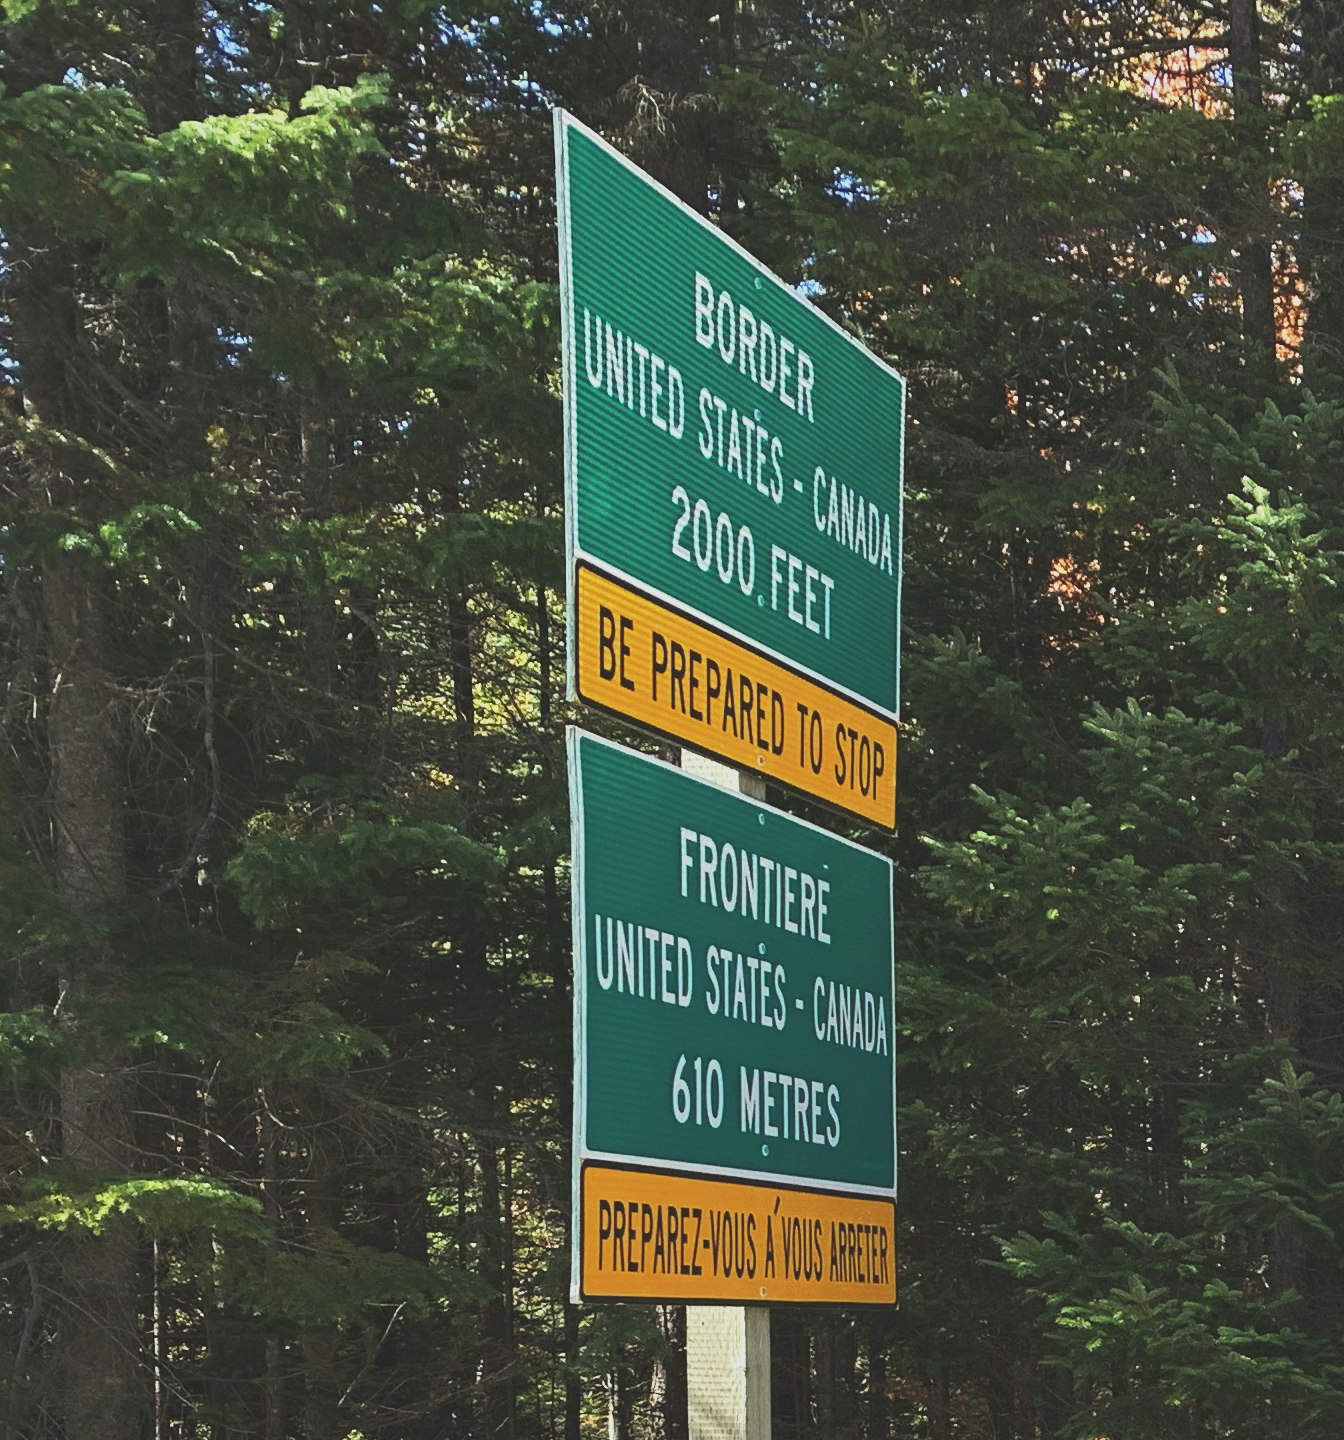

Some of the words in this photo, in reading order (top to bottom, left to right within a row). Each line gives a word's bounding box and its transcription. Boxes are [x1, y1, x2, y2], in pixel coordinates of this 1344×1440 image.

[695, 270, 815, 424] BORDER
[584, 306, 686, 440] UNITED
[699, 387, 784, 504] STATES
[793, 478, 804, 493] -
[813, 465, 893, 577] CANADA
[671, 485, 756, 597] 2000
[771, 543, 835, 641] FEET
[599, 604, 635, 692] BE
[652, 631, 785, 757] PREPARED
[797, 702, 823, 776] TO
[834, 723, 885, 801] STOP
[680, 826, 832, 945] FRONTIERE
[595, 914, 693, 1009] UNITED
[706, 945, 786, 1032] STATES
[795, 998, 804, 1010] -
[813, 976, 888, 1057] CANADA
[672, 1054, 725, 1129] 610
[740, 1065, 841, 1148] METRES
[598, 1198, 758, 1280] PREPAREZ-VOUS
[781, 1215, 824, 1283] VOUS
[829, 1220, 890, 1285] ARRETER
